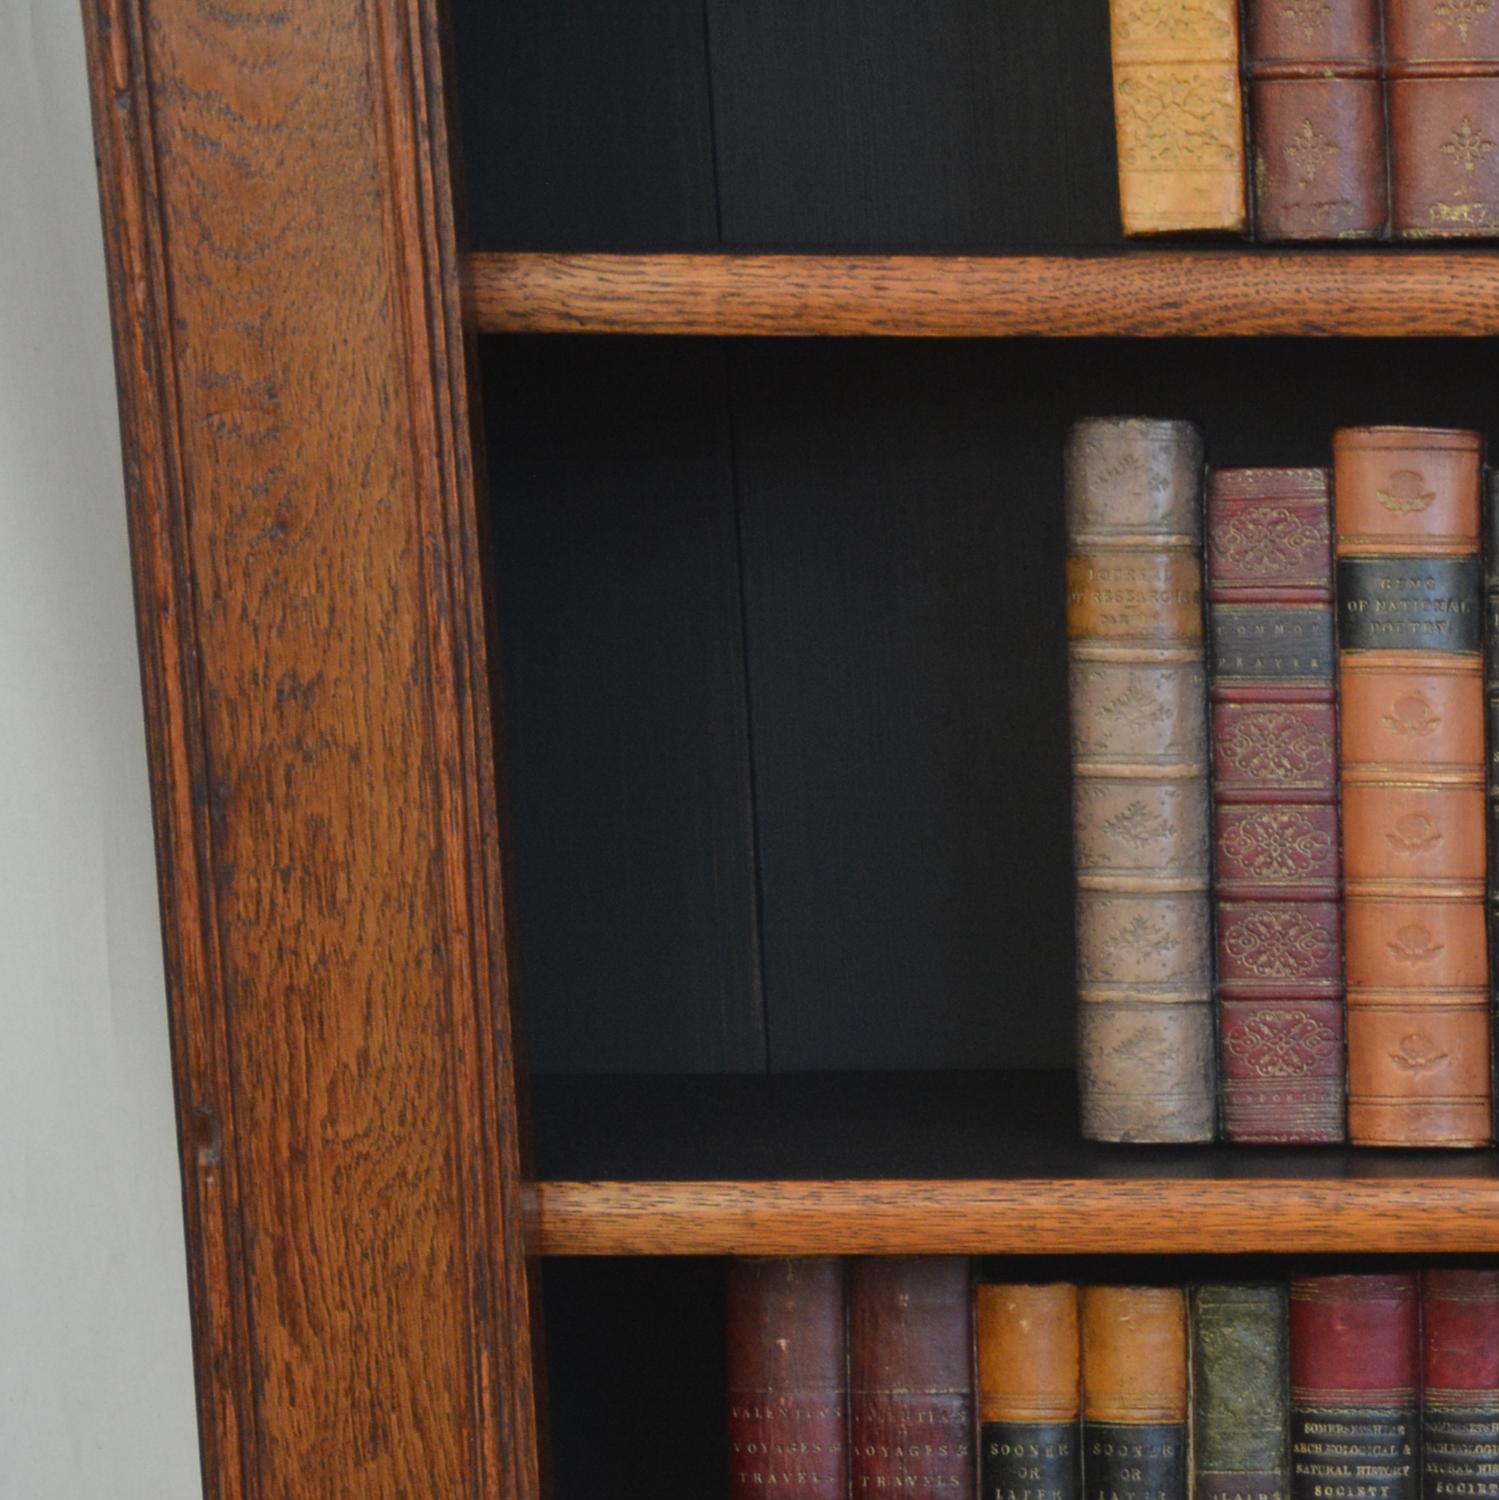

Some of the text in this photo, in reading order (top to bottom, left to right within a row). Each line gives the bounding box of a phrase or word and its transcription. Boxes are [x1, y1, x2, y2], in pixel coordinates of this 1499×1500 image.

[1347, 600, 1473, 614] OF NATIONAL
[1303, 1421, 1407, 1437] SOMERSETSHIRE
[854, 1444, 951, 1458] VOYAGES
[990, 1443, 1071, 1460] SOONER
[1092, 1443, 1176, 1460] SOONER
[1018, 1467, 1041, 1481] OR
[1119, 1467, 1143, 1482] OR
[1295, 1464, 1412, 1479] NATURAL HISTORY
[1313, 1484, 1392, 1500] SOCIETY
